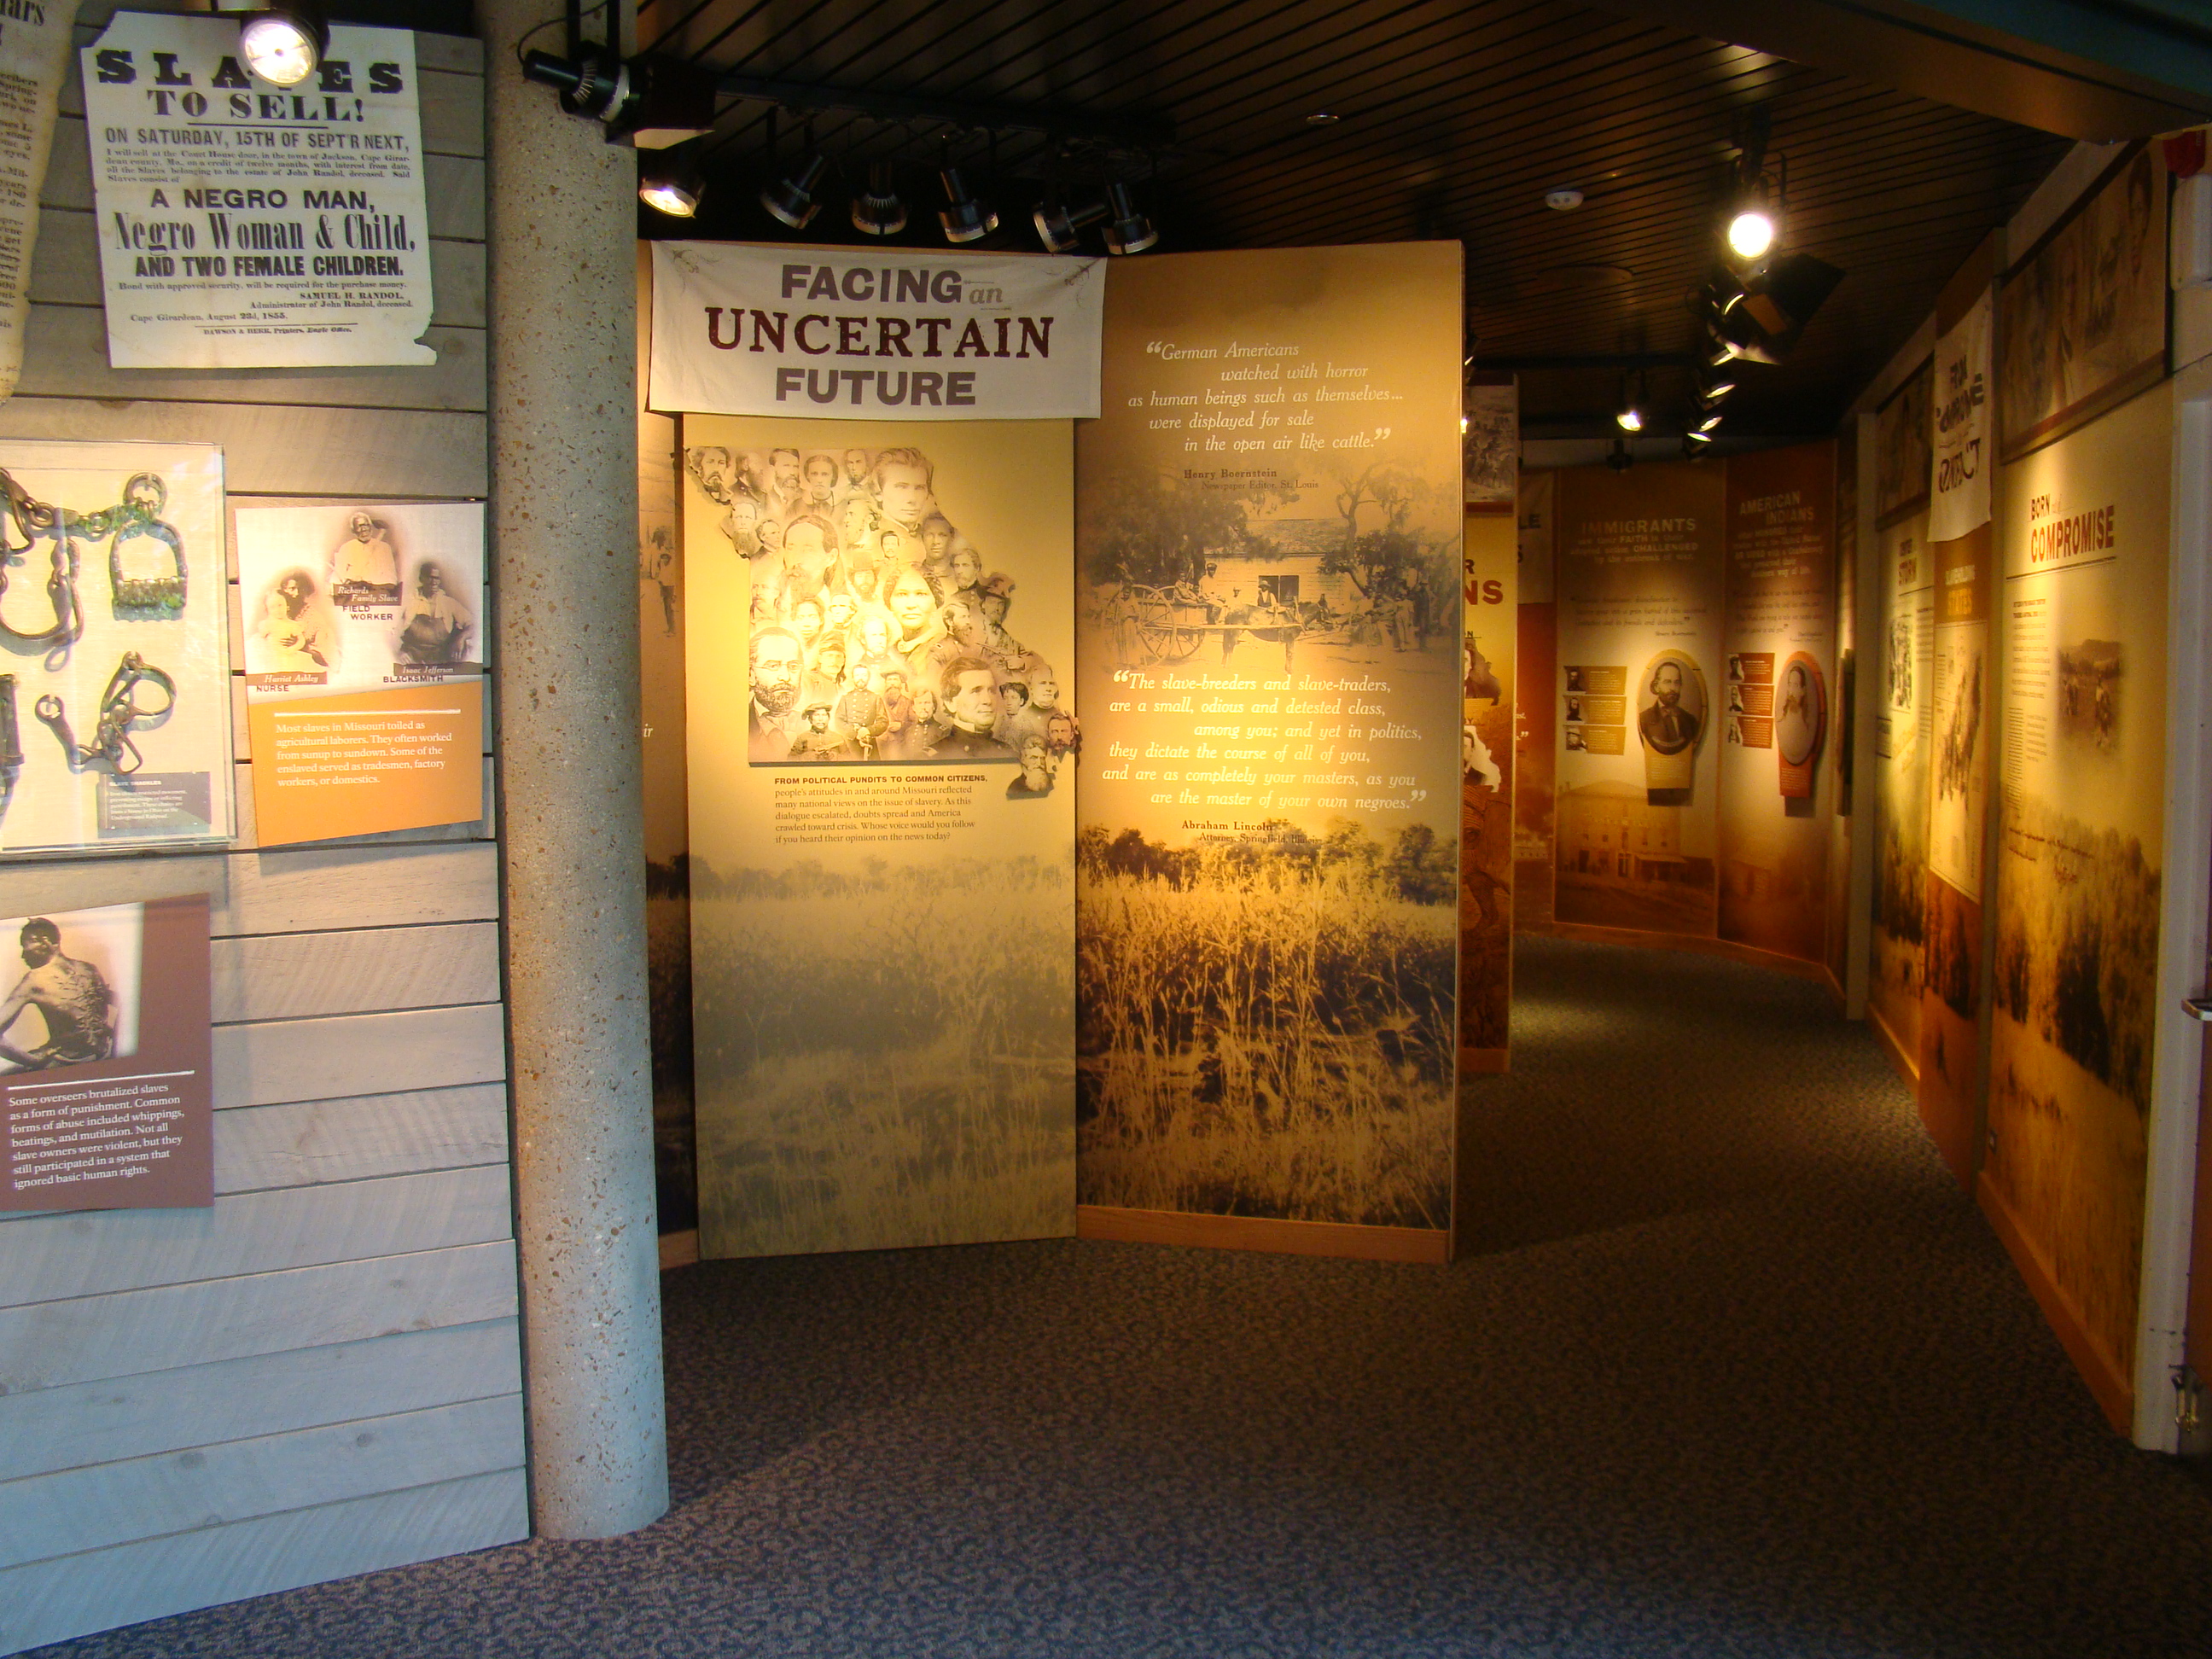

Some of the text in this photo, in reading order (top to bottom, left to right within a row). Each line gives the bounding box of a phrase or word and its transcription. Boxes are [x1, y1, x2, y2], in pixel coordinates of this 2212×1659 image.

[96, 49, 404, 94] SLAES
[146, 90, 364, 122] TO SELL!
[106, 127, 127, 143] ON
[137, 128, 229, 148] SATURDAY,
[236, 131, 275, 147] 15TH
[281, 131, 299, 148] OF
[364, 134, 409, 152] NEXT,
[150, 188, 375, 213] A NEGRO MAN,
[114, 212, 415, 255] Negro Woman & Child,
[136, 255, 404, 276] AND TWO FEMALE CHILDREN.
[781, 264, 962, 303] FACING
[969, 288, 1003, 305] an
[704, 306, 1054, 358] UNCERTAIN
[1224, 341, 1299, 358] Americans
[1220, 362, 1369, 381] watched with horror
[776, 367, 975, 405] FUTURE
[1128, 397, 1143, 406] as
[1150, 390, 1197, 406] human
[1205, 388, 1246, 406] beings
[1254, 387, 1285, 403] such
[1292, 393, 1308, 402] as
[1149, 409, 1314, 431] were displayed for sale
[1185, 437, 1197, 451] in
[1205, 434, 1225, 451] the
[1233, 439, 1265, 452] open
[1272, 435, 1293, 449] air
[1299, 432, 1324, 451] like
[1184, 468, 1277, 480] Henry Boernstein
[1740, 491, 1801, 515] AMERICAN
[1581, 518, 1697, 534] IMMIGRANTS
[2031, 505, 2114, 563] COMPROMISE
[337, 585, 369, 595] Richards
[351, 594, 376, 602] Family
[264, 674, 318, 683] Harriet Ashley
[402, 666, 454, 674] Isaac Jefferson
[1161, 672, 1256, 690] slave-breeders
[1263, 674, 1291, 690] and
[1297, 674, 1390, 693] slave-traders,
[1109, 698, 1385, 716] are a small, odious and detested class,
[276, 724, 301, 733] Most
[302, 723, 330, 732] slaves
[332, 722, 341, 731] in
[344, 721, 385, 731] Missouri
[387, 720, 413, 730] toiled
[1193, 722, 1422, 741] among you; and yet in politics,
[276, 732, 452, 748] agricultural laborers. They often worked
[1109, 741, 1370, 764] they dictate the course of all of you,
[808, 787, 843, 795] attitudes
[871, 786, 899, 795] around
[939, 785, 972, 794] reflected
[1181, 819, 1273, 831] Abraham Lincoln
[9, 1084, 169, 1107] Some overseers brutalized slaves
[31, 1108, 55, 1118] form
[57, 1104, 69, 1115] of
[70, 1101, 132, 1116] punishment.
[134, 1097, 180, 1108] Common
[10, 1109, 184, 1133] forms of abuse included whippings,
